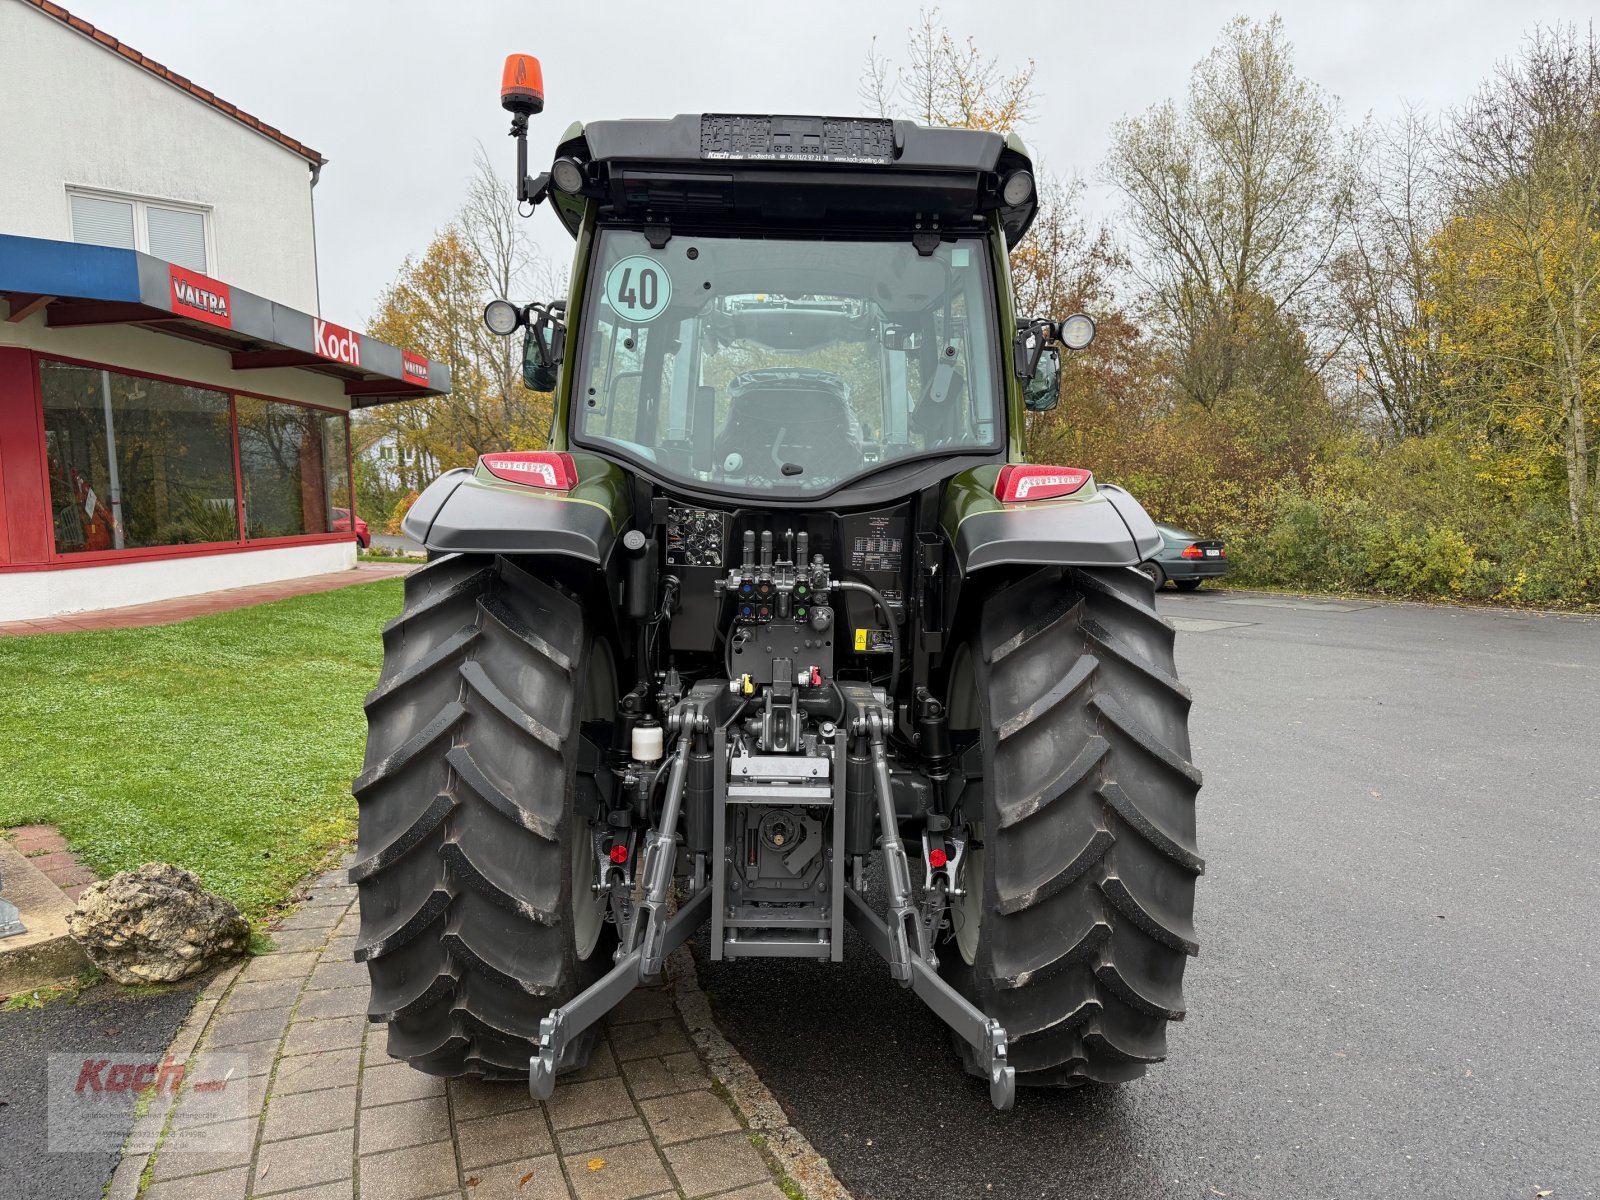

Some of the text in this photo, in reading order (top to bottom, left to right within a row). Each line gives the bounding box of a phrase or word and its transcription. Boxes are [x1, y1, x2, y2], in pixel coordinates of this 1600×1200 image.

[707, 151, 730, 159] Koch
[172, 275, 229, 318] VALTRA
[618, 267, 658, 310] 40
[313, 317, 360, 366] Koch
[404, 358, 429, 380] VALTRA
